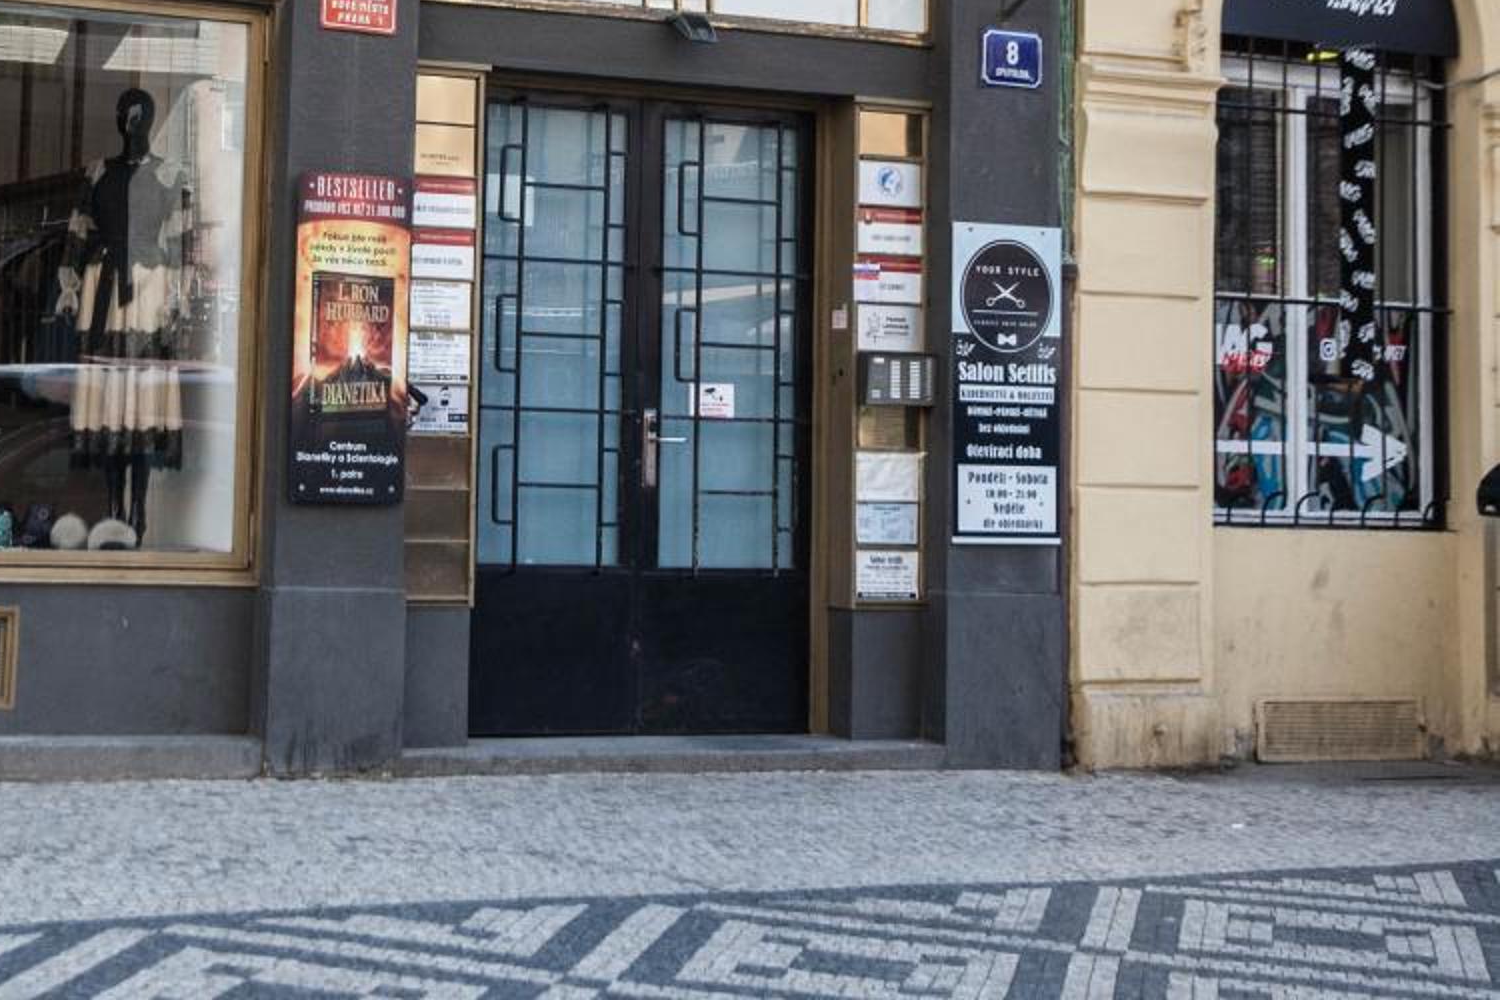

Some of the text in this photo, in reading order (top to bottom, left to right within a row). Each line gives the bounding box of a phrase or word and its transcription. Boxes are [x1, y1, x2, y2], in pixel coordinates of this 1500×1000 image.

[1006, 41, 1019, 65] 8
[975, 265, 1040, 277] YOUR STYLE
[351, 284, 379, 302] RON
[325, 301, 388, 322] HUBBARD
[958, 361, 1057, 385] Salon Setifis
[323, 380, 387, 405] DIANETIKA
[329, 441, 367, 452] Centrum
[1016, 445, 1042, 459] doba
[338, 454, 345, 463] a
[1015, 472, 1048, 485] Sobota
